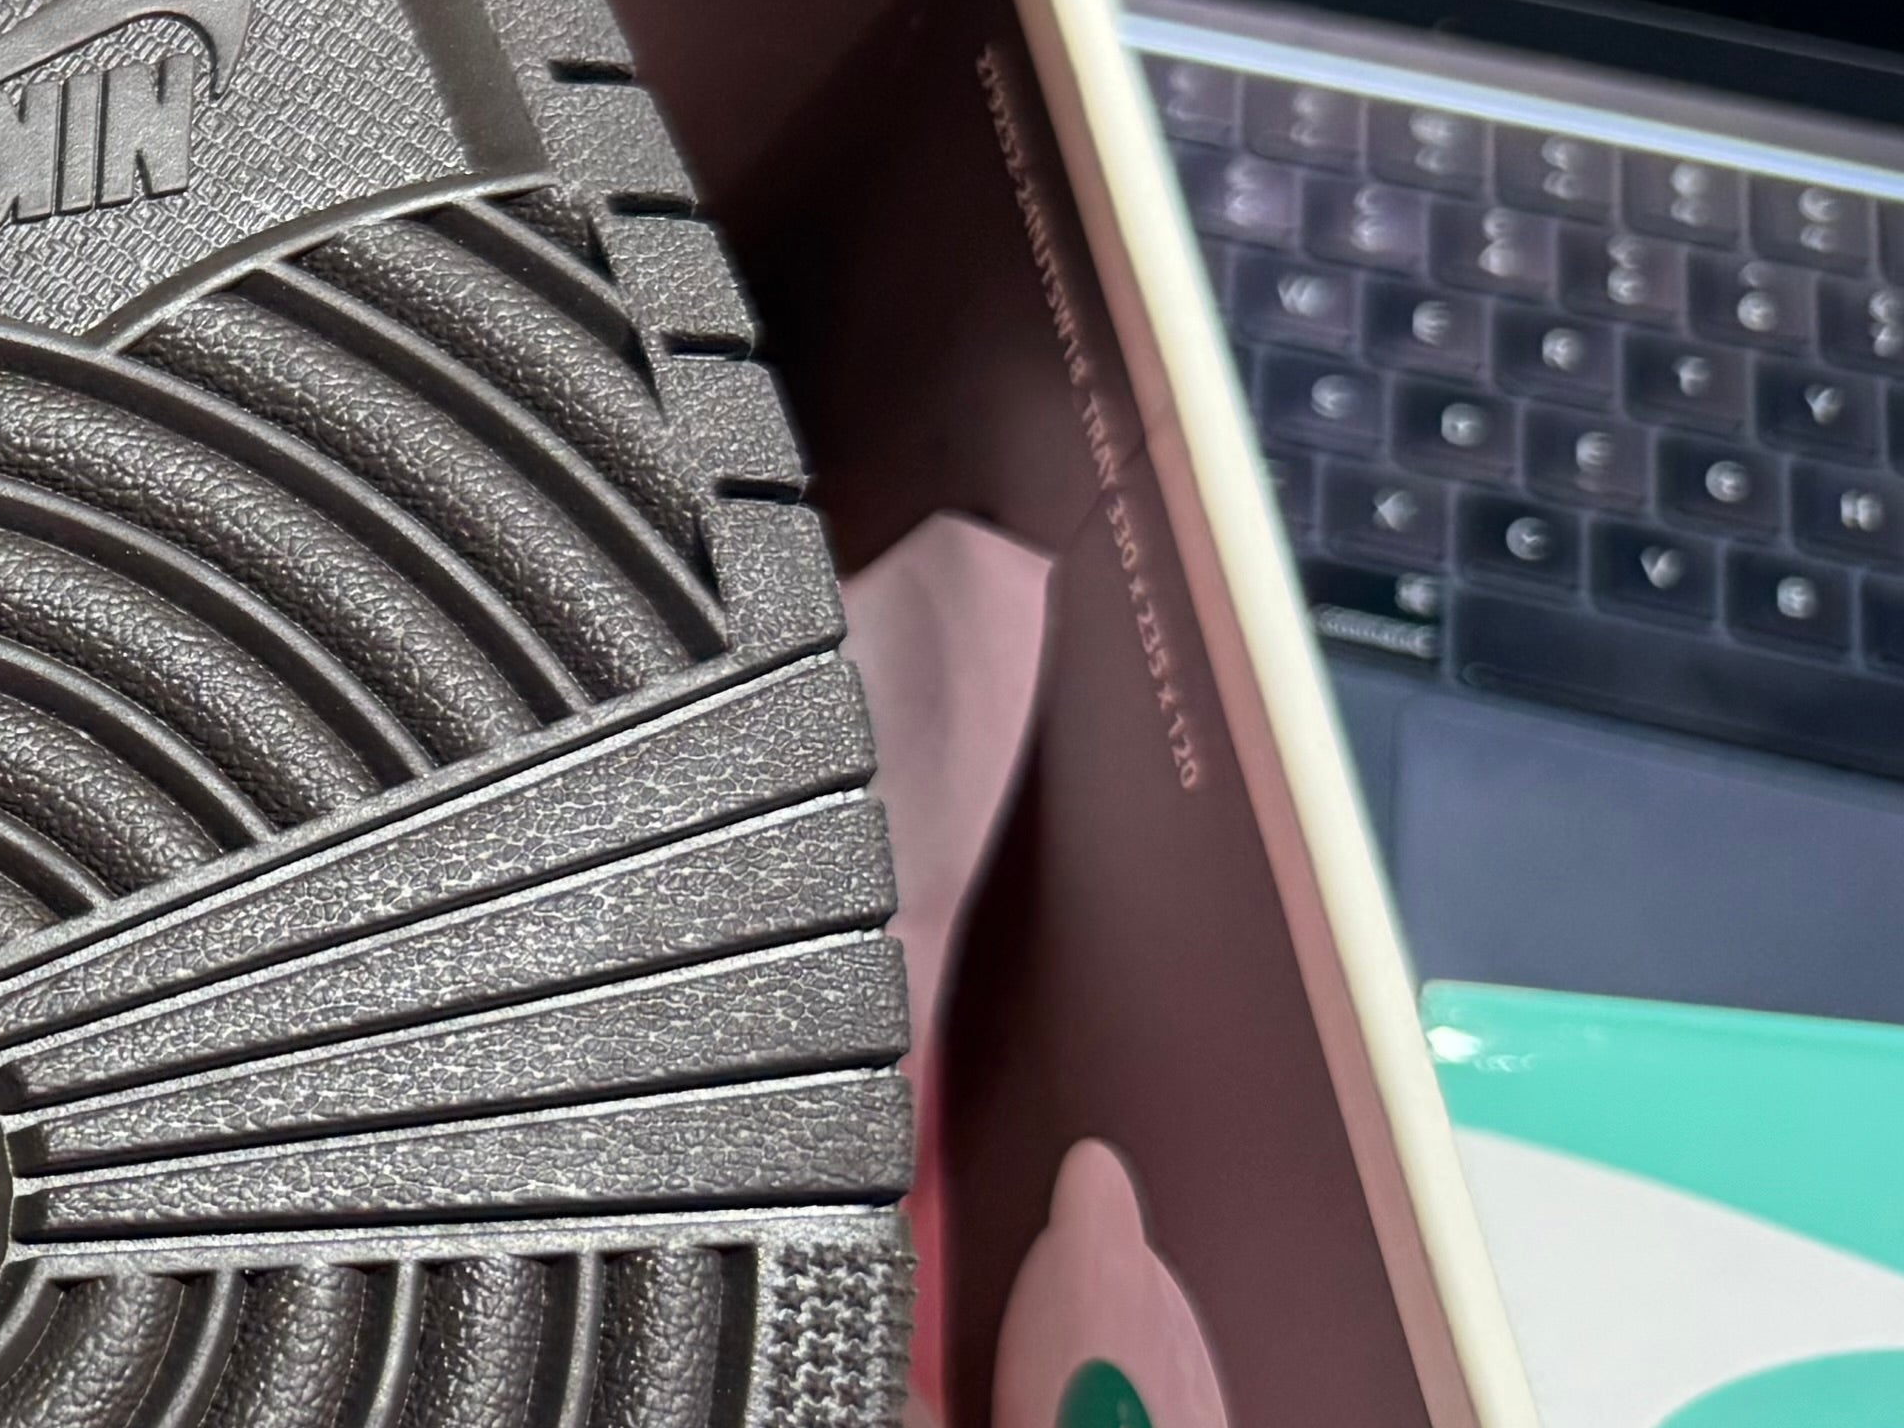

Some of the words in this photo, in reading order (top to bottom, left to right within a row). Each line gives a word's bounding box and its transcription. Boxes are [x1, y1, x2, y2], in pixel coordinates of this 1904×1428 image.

[1106, 492, 1137, 572] 330
[1137, 602, 1167, 679] 235
[1168, 713, 1197, 789] 120
